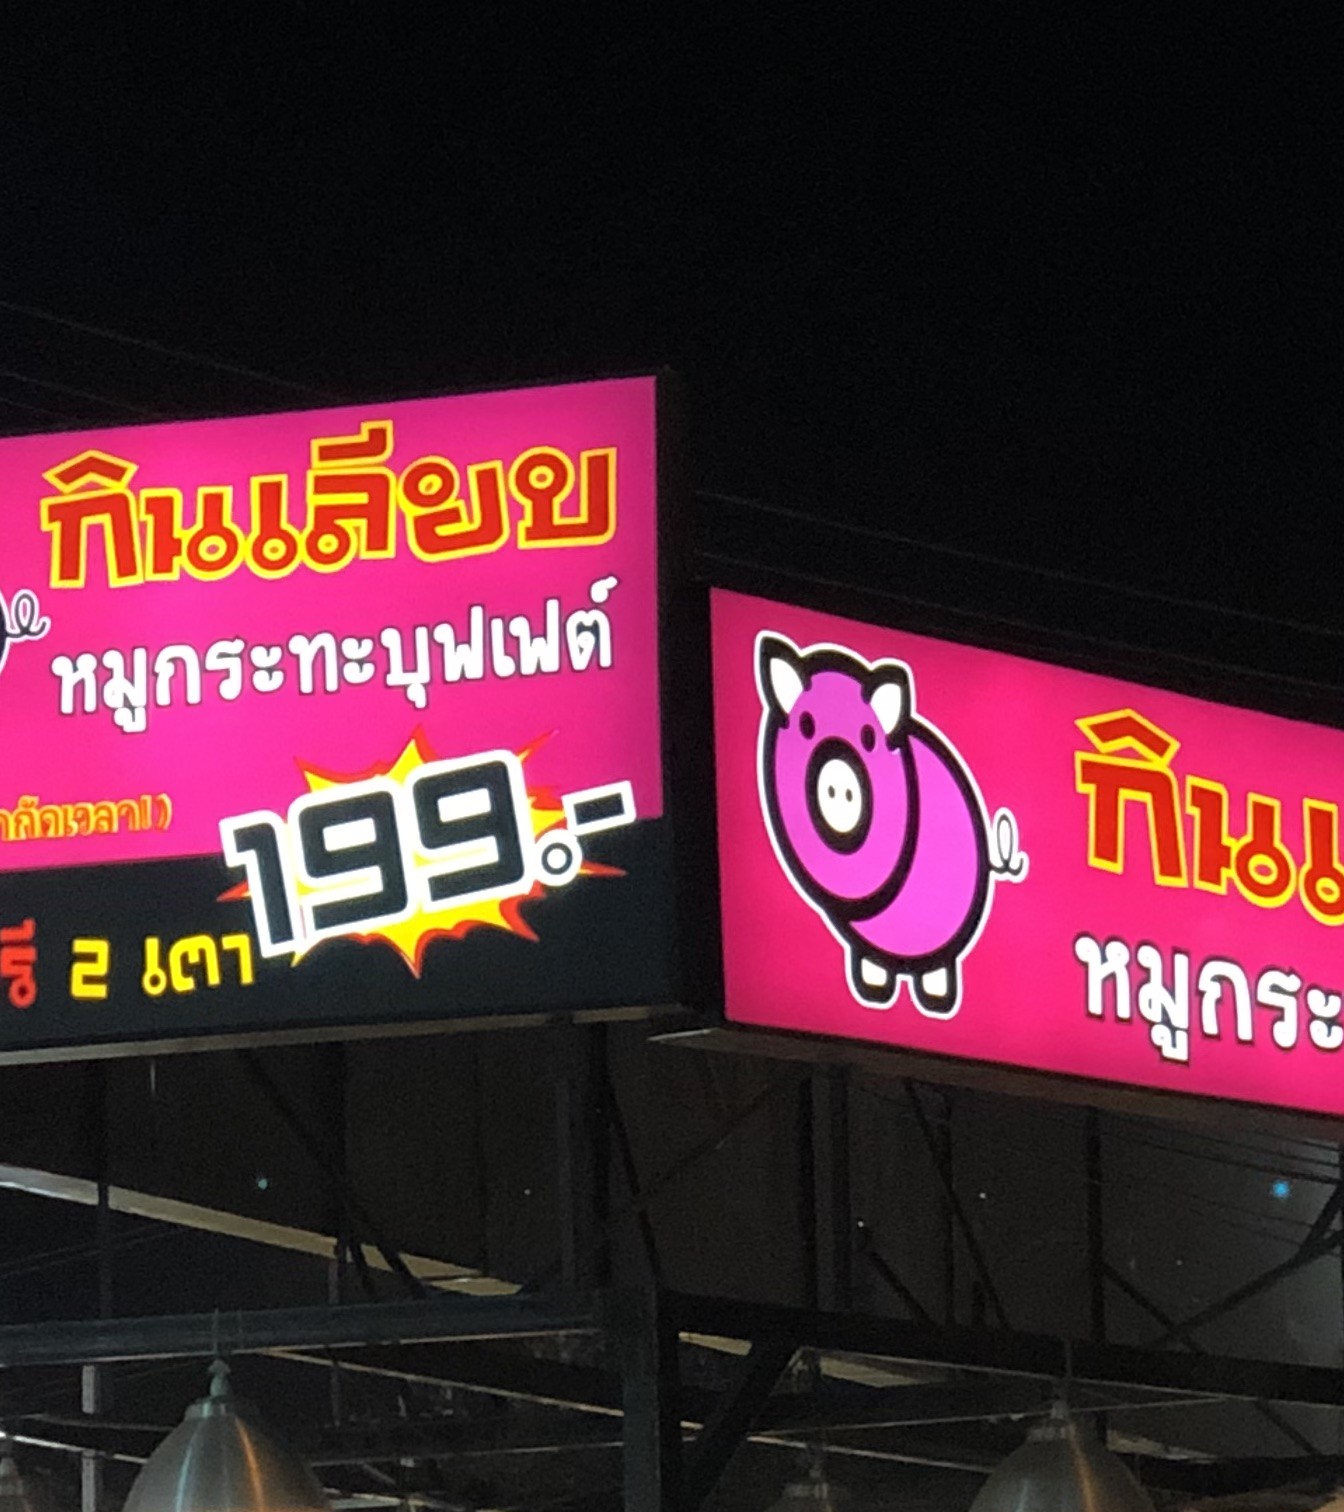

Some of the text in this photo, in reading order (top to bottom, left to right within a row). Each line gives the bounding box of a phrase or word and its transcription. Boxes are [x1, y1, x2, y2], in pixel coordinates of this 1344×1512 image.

[41, 420, 618, 588] กินเลียบ
[52, 577, 618, 733] หมูกระทะบุฟเฟต์
[220, 750, 636, 957] 199.-
[70, 938, 110, 999] 2
[143, 933, 255, 995] เตา
